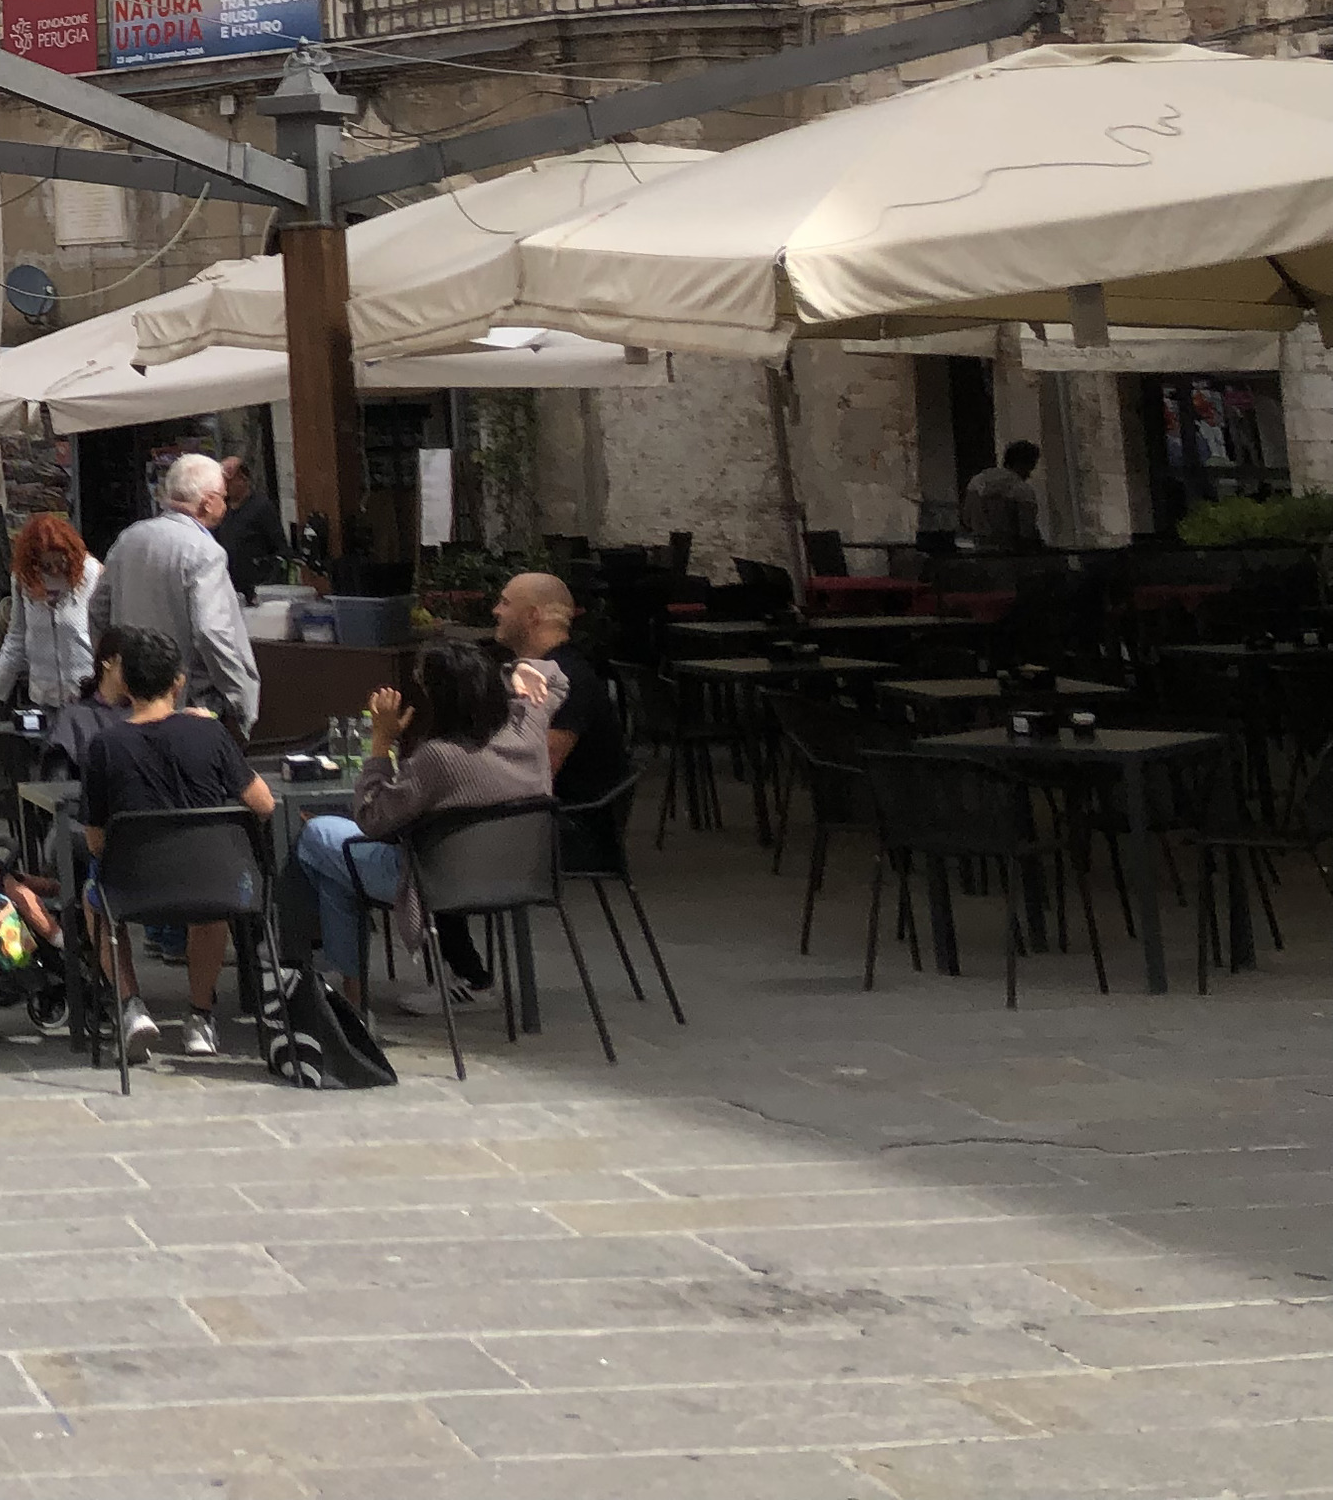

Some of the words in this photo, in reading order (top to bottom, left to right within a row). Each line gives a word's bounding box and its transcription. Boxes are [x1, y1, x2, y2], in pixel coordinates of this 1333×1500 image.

[37, 13, 89, 30] FONDAZIONE
[220, 8, 259, 24] RIUSO
[37, 27, 90, 48] PERUGIA
[115, 17, 203, 51] UTOPIA
[220, 26, 230, 39] E
[231, 19, 283, 38] FUTURO
